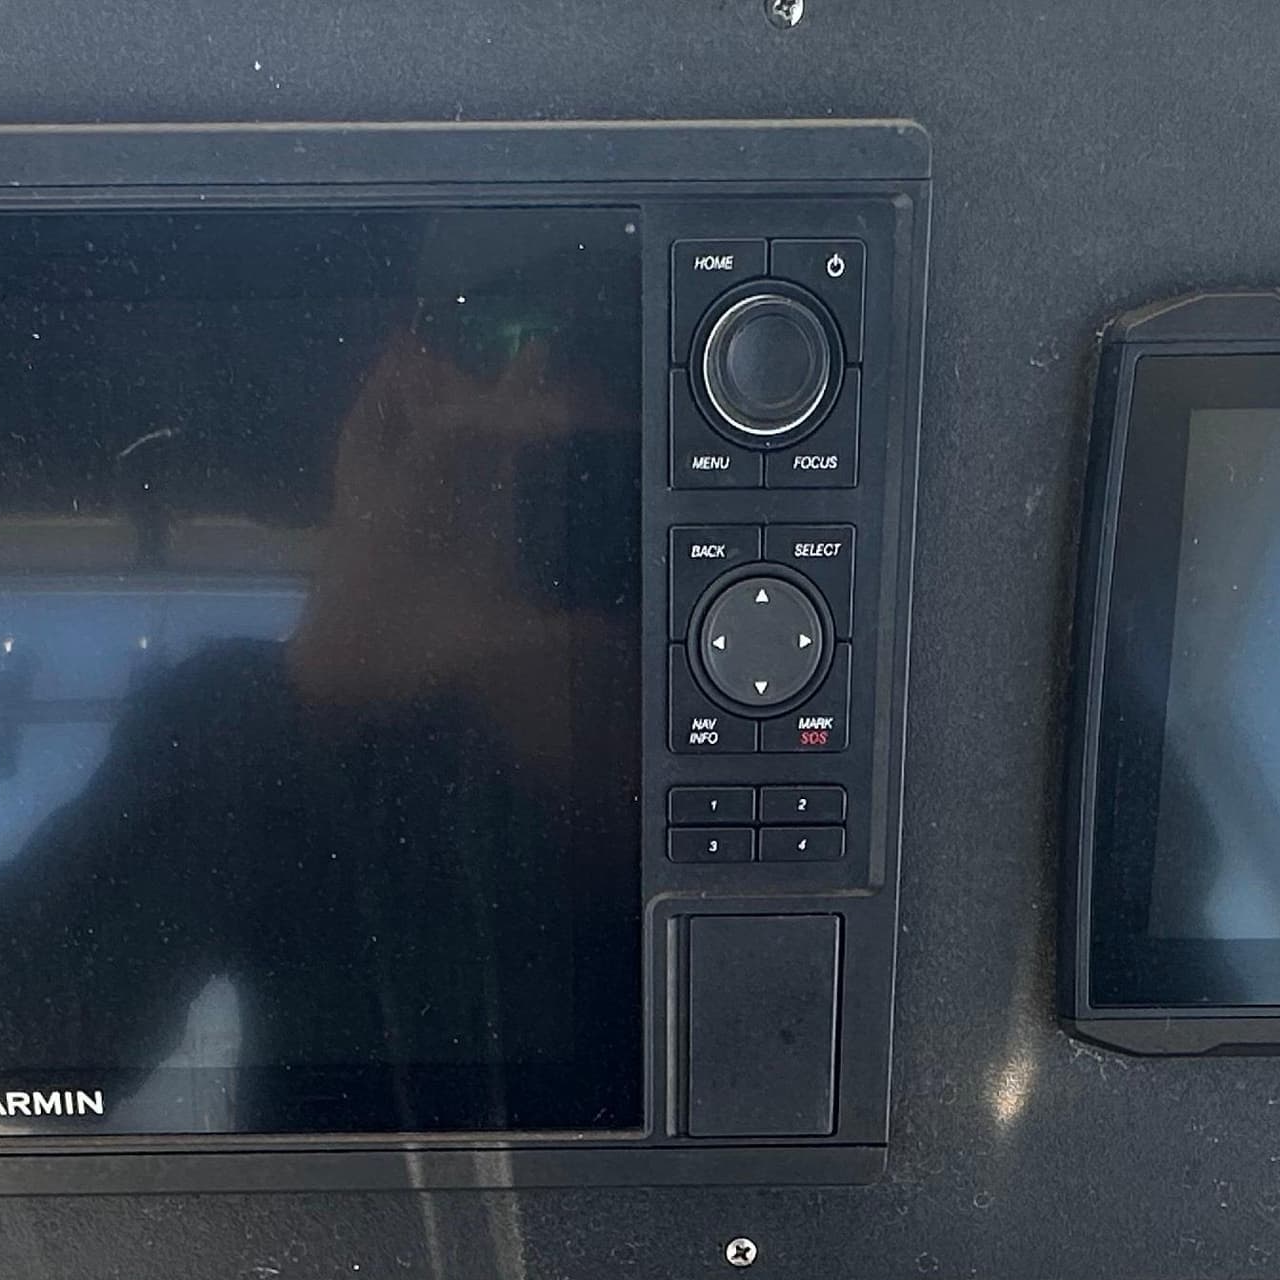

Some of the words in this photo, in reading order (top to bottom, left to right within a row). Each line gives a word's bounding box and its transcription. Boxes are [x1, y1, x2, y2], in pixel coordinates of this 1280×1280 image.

[694, 255, 734, 271] HOME
[692, 456, 730, 470] MENU
[793, 455, 838, 470] FOCUS
[691, 544, 725, 558] BACK
[794, 543, 842, 557] SELECT
[691, 718, 718, 730] NAV
[798, 717, 834, 730] MARK
[689, 731, 719, 745] INFO
[801, 730, 828, 745] SOS
[710, 800, 719, 811] 1
[798, 799, 808, 811] 2
[708, 840, 718, 852] 3
[798, 839, 807, 850] 4
